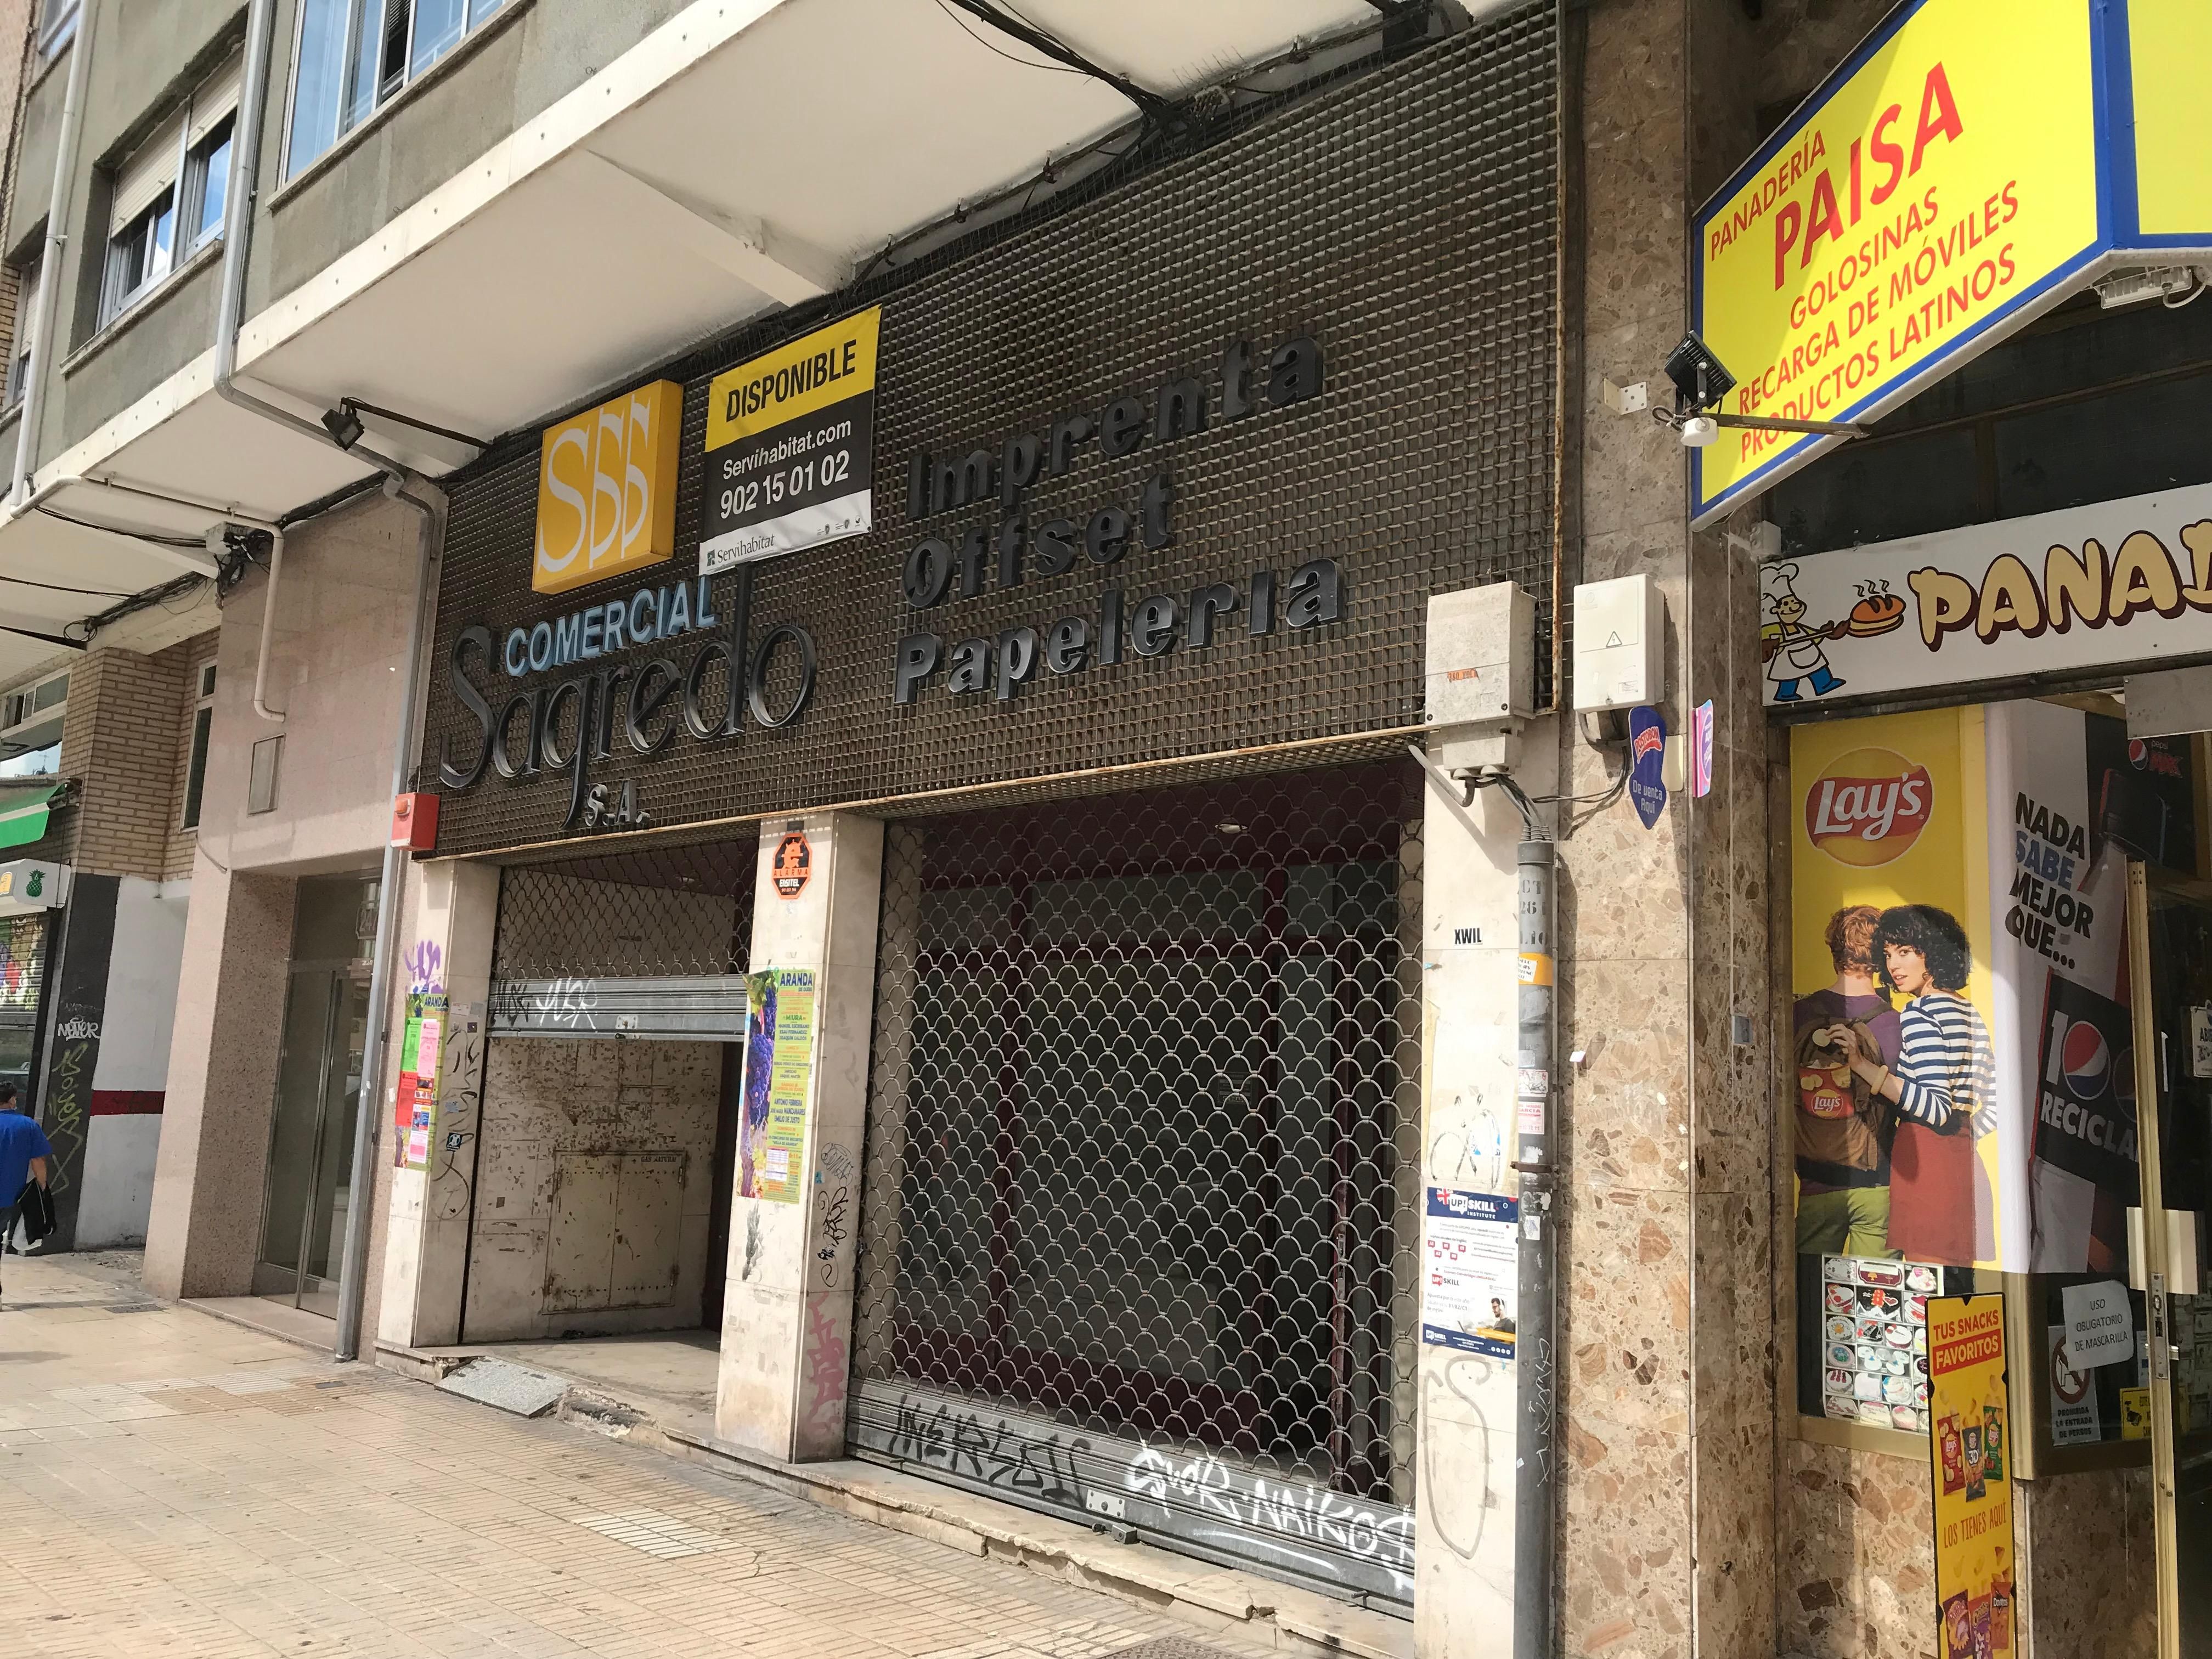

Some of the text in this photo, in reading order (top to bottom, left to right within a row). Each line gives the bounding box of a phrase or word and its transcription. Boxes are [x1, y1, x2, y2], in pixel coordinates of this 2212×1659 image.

[1711, 129, 1825, 261] PANADERÍA
[1775, 61, 1964, 291] PAISA
[1791, 186, 1938, 330] GOLOSINAS
[1740, 180, 2019, 415] RECARGA DE MÓVILES
[1742, 243, 2016, 463] PRODUCTOS LATINOS
[726, 339, 857, 422] DISPONIBLE
[723, 419, 851, 481] Servihabitat.com
[906, 335, 1323, 520] Imprenta
[720, 450, 849, 520] 902 15 01 02
[716, 533, 775, 564] Servihabitat
[901, 471, 1173, 608] Offset
[505, 574, 719, 676] COMERCIAL
[440, 562, 816, 830] Sagredo
[584, 779, 651, 827] S.A.
[1633, 780, 1663, 801] De venta
[1814, 772, 1925, 840] Lay's
[2016, 792, 2085, 860] NADA
[774, 868, 808, 877] ALARMA
[2015, 831, 2075, 891] SABE
[2009, 868, 2094, 939] MEJOR
[424, 996, 449, 1008] ARANDA
[780, 973, 812, 986] ARANDA
[1814, 1096, 1841, 1112] Lay's
[2041, 1091, 2138, 1163] RECICLA
[1451, 1199, 1496, 1212] UP! SKILL
[1467, 1211, 1496, 1220] INSTITUTE
[1443, 1278, 1459, 1286] SKILL
[2090, 1299, 2106, 1311] USO
[1933, 1309, 1999, 1341] TUS SNACKS
[2075, 1331, 2128, 1352] DE MASCARILLA
[2076, 1313, 2123, 1332] OBLIGATORIO
[1936, 1335, 1999, 1369] FAVORITOS
[2059, 1430, 2068, 1438] DE
[2065, 1417, 2093, 1426] ENTRADA
[1944, 1497, 2006, 1549] LOS TIENES AQUÍ
